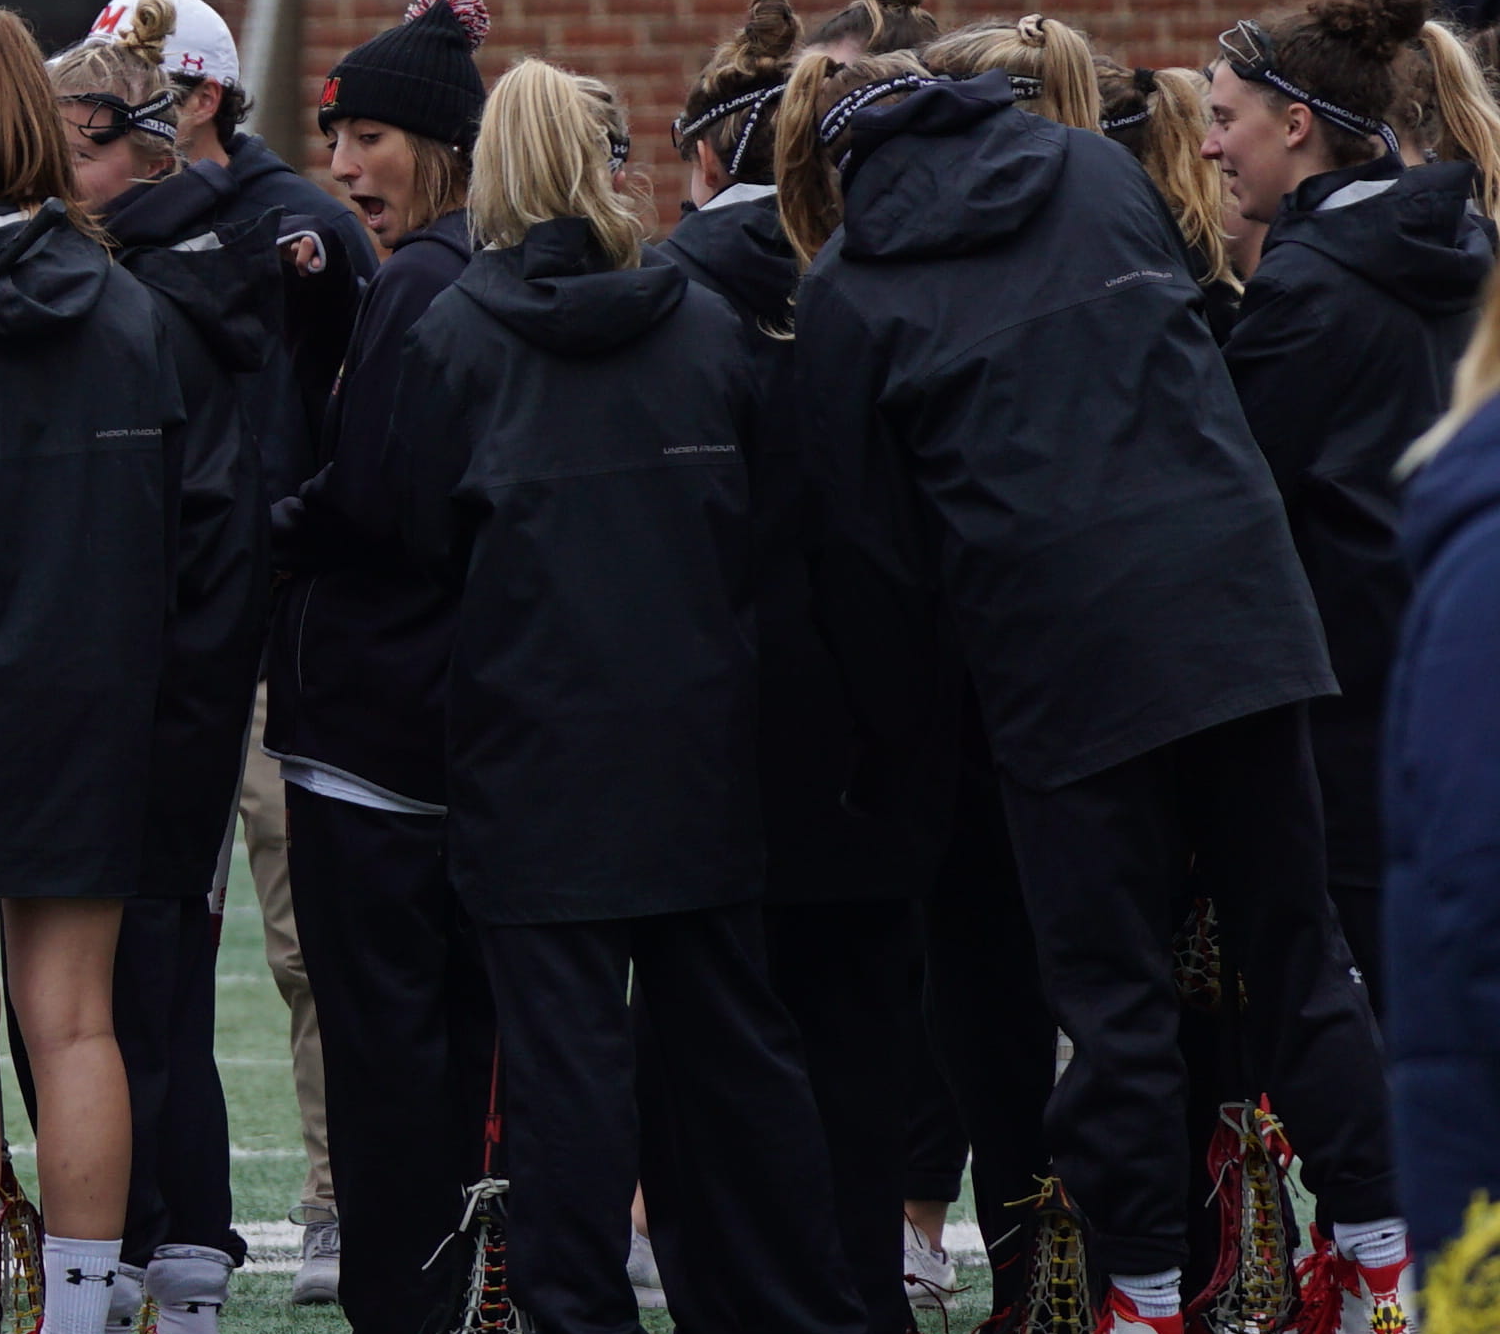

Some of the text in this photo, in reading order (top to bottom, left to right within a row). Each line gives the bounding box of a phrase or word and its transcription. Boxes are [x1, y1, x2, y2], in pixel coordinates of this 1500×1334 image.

[1265, 69, 1364, 124] UNDER ARMOUR
[663, 446, 698, 455] UNDER
